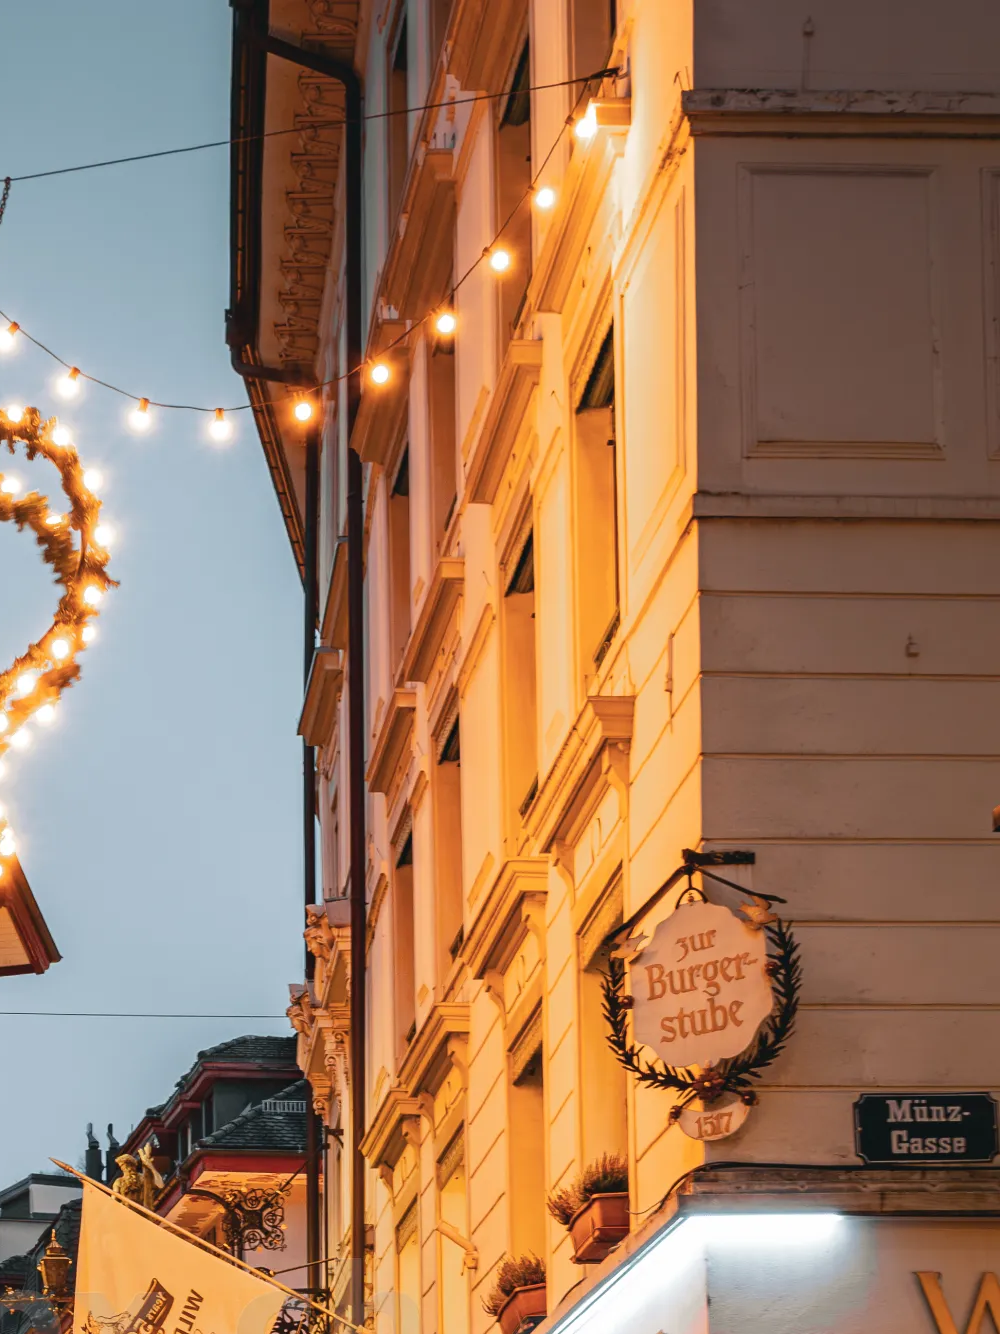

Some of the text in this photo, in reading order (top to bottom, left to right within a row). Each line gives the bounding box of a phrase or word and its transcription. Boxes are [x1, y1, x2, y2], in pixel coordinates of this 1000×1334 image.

[674, 929, 717, 962] zur
[644, 950, 758, 1001] Burger-
[660, 997, 744, 1043] stube
[695, 1111, 734, 1139] 1517
[886, 1100, 971, 1124] Münz-
[891, 1129, 967, 1154] Gasse
